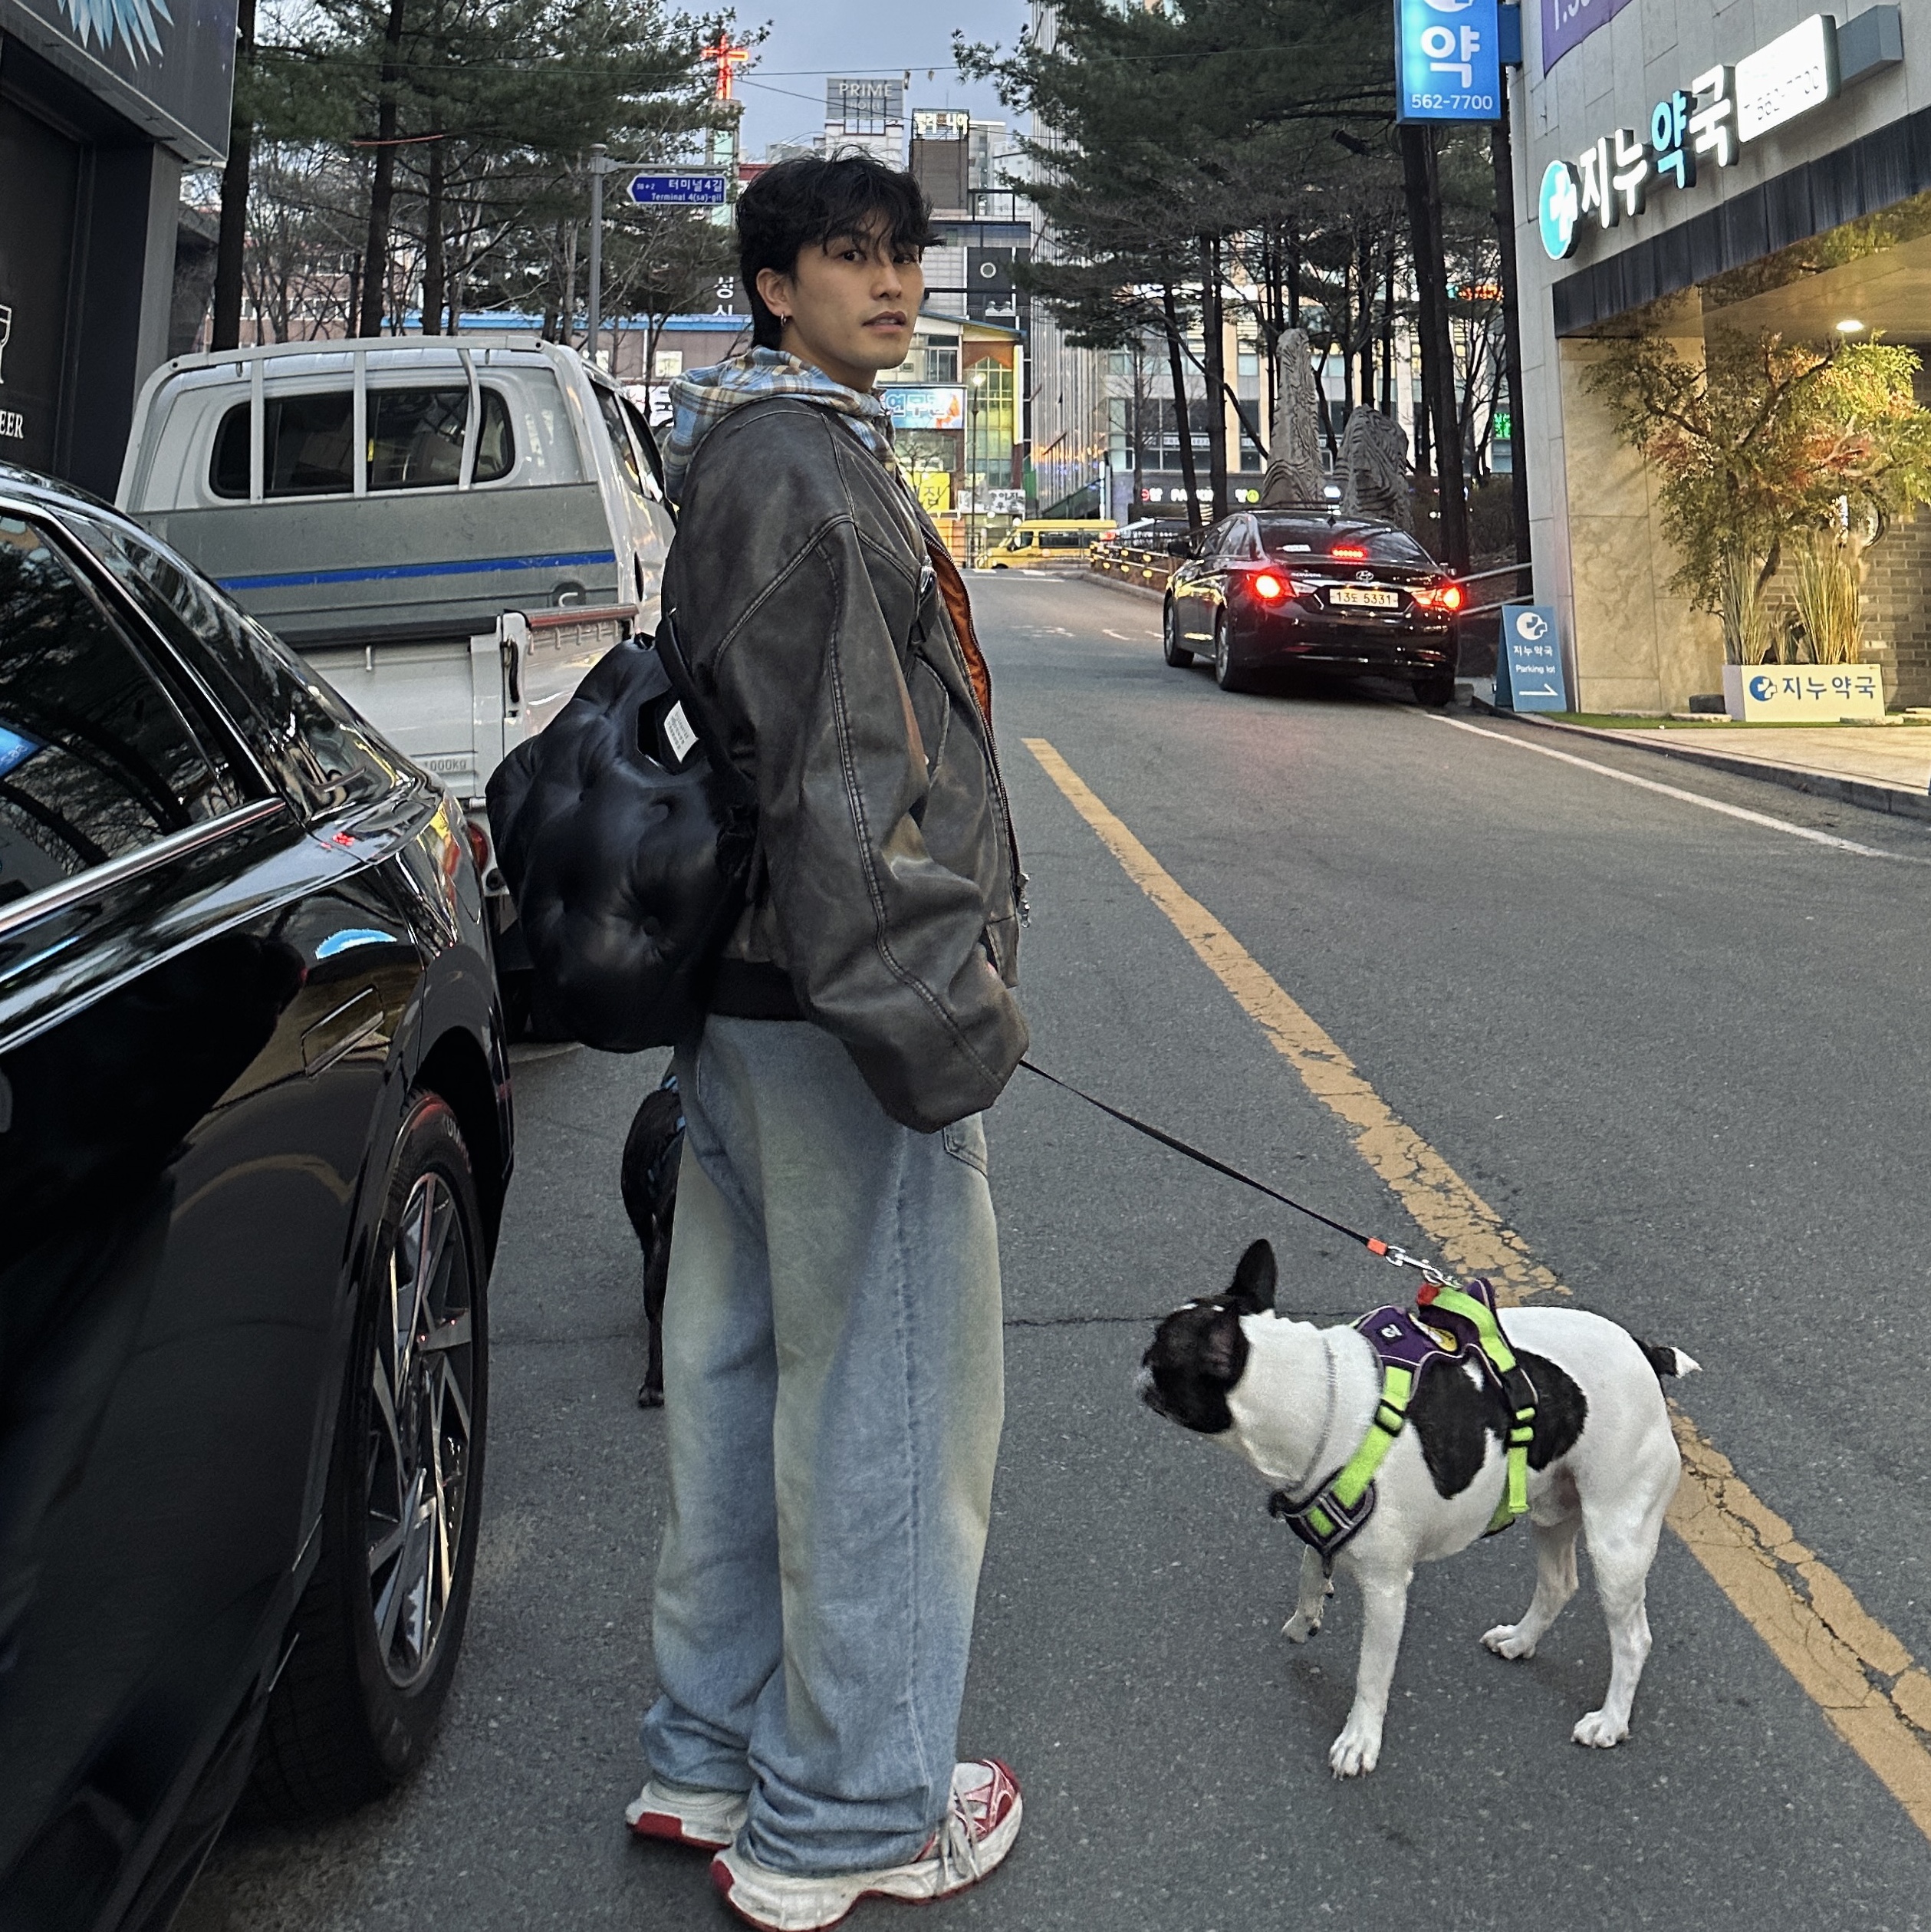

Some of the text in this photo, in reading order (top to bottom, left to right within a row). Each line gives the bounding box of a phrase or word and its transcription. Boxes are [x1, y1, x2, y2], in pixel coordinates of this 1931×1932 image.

[1420, 25, 1480, 88] 약
[839, 83, 893, 97] PRIME
[1411, 94, 1493, 110] 562-7700
[1579, 64, 1731, 229] 지누약국
[668, 179, 722, 193] 터미널4길
[651, 193, 686, 201] Terminal
[1364, 593, 1391, 605] 5331
[1513, 645, 1554, 657] 지누약국
[1515, 664, 1556, 674] Parking lot
[1781, 676, 1877, 700] 지누약국
